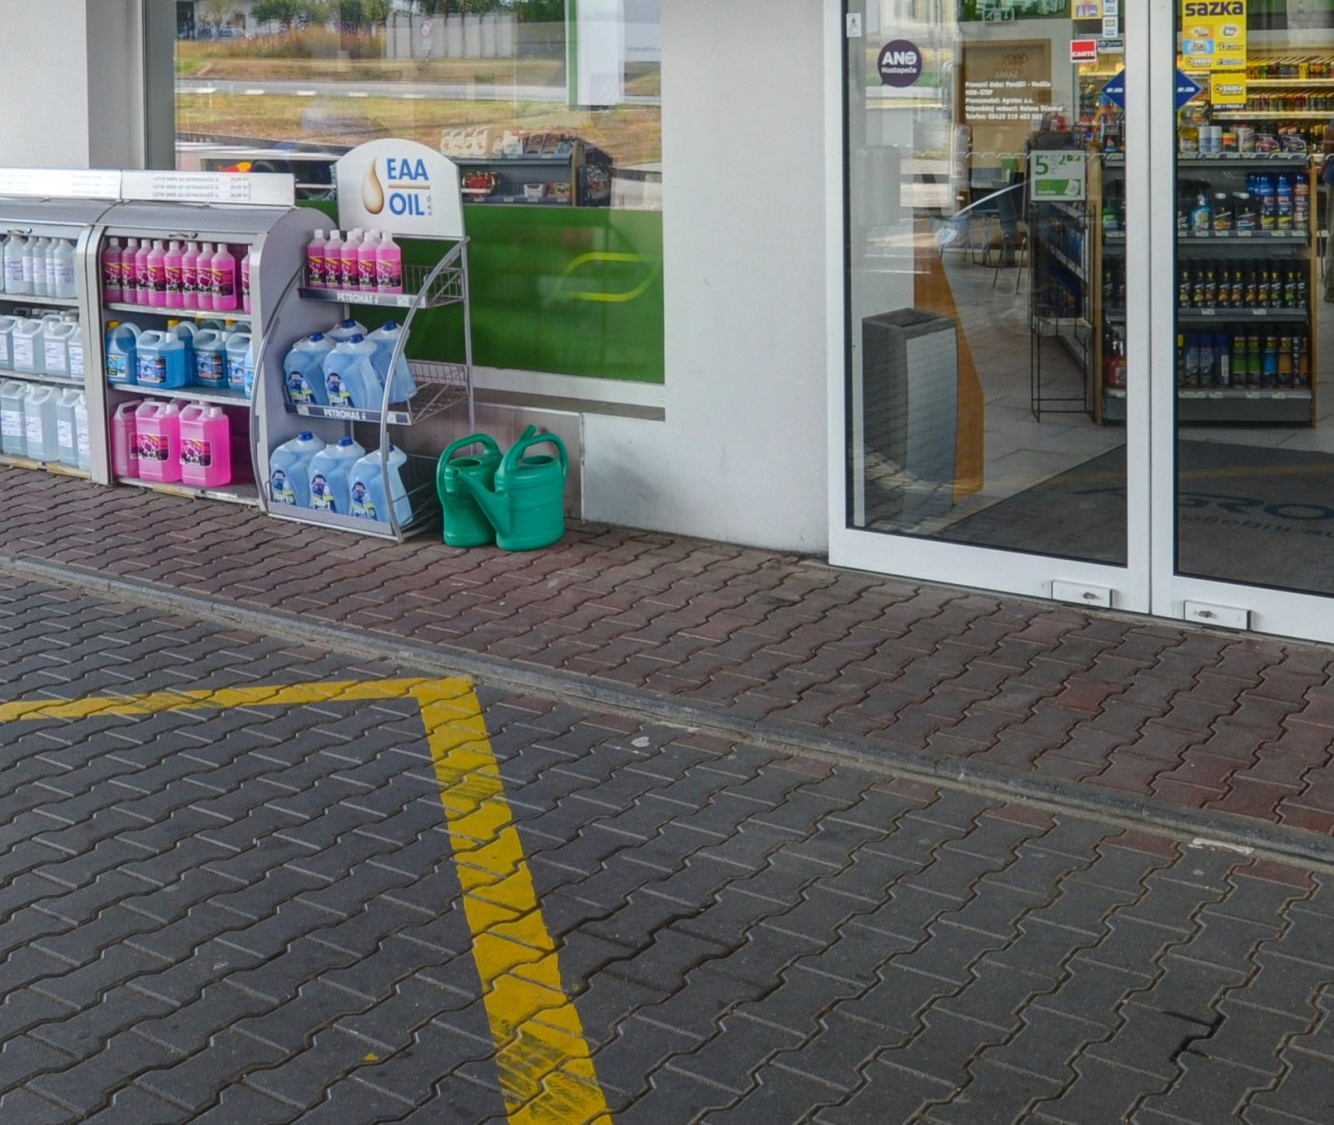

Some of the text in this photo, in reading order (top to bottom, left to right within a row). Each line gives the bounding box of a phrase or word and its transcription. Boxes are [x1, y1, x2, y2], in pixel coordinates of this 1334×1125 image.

[882, 51, 917, 65] ANO
[881, 66, 917, 75] Hustopeče
[387, 158, 428, 180] EAA
[389, 192, 424, 216] OIL
[337, 292, 373, 304] PETRONAS
[323, 408, 360, 421] PETRONAS
